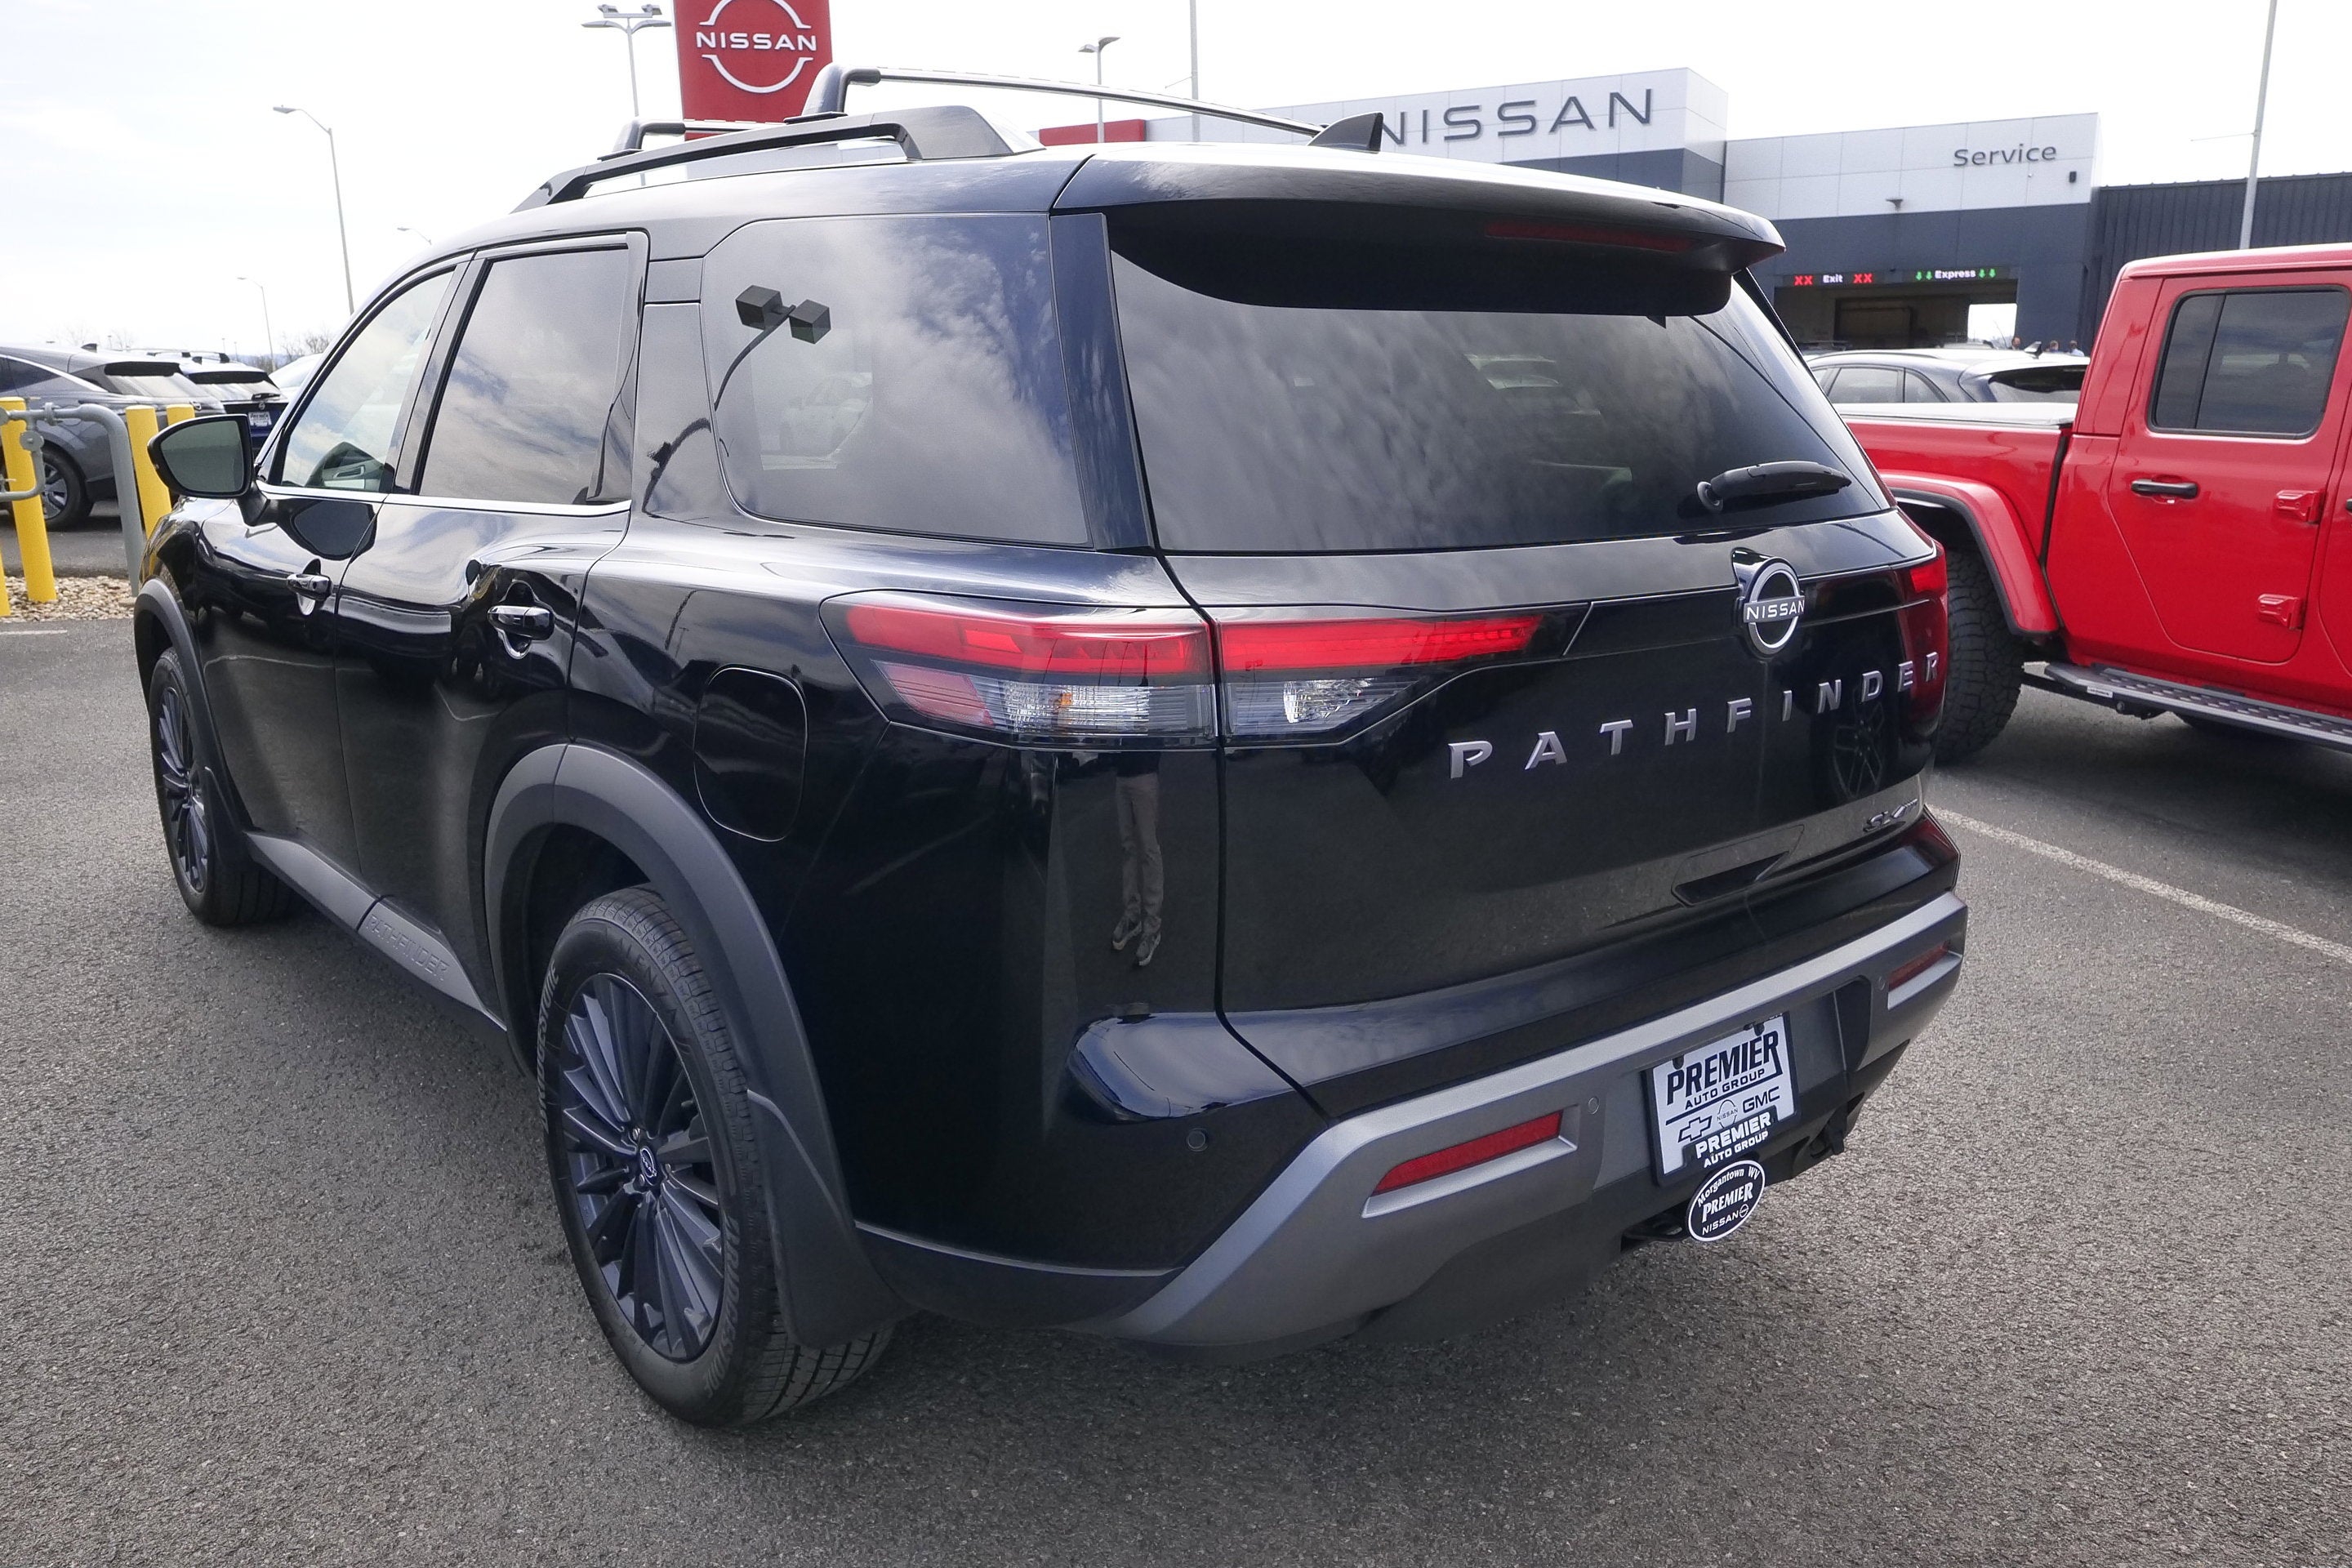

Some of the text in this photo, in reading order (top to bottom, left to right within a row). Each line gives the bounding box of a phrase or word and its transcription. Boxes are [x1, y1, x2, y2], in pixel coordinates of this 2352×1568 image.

[696, 31, 817, 51] NISSAN
[1953, 143, 2057, 167] Service
[1822, 274, 1843, 283] Exit
[1934, 269, 1976, 279] Express
[1746, 599, 1806, 620] NISSAN
[1449, 652, 1940, 779] PATHFINDER
[1667, 1031, 1783, 1106] PREMIER
[1685, 1068, 1765, 1110] AUTO GROUP
[1717, 1086, 1780, 1121] NISSAN GMC
[1695, 1111, 1771, 1159] PREMIER
[1704, 1130, 1769, 1168] AUTO GROUP
[1698, 1165, 1760, 1208] Morgantown WV
[1701, 1182, 1753, 1223] PREMIER
[1702, 1209, 1739, 1236] NISSAN
